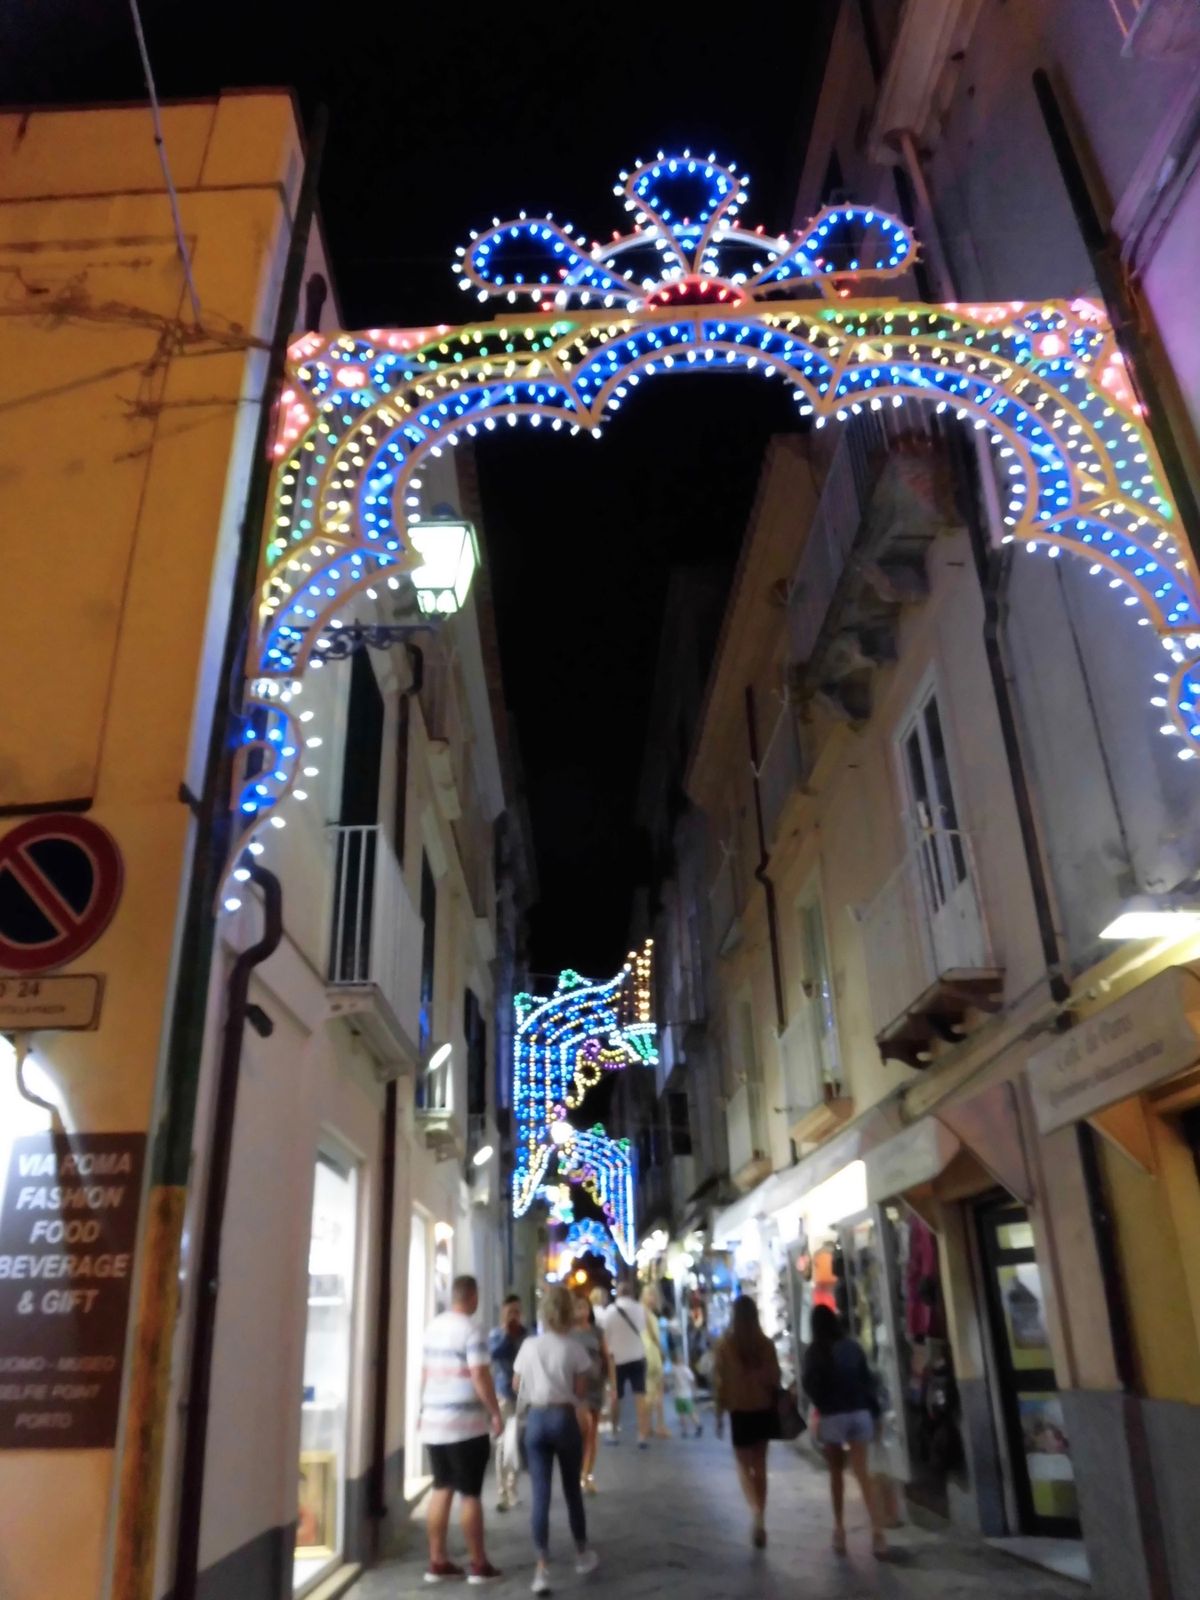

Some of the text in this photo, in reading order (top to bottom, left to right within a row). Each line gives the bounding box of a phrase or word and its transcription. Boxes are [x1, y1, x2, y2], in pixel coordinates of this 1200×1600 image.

[18, 1152, 132, 1177] VIA ROMA
[15, 1186, 124, 1210] FASHION
[29, 1220, 101, 1244] FOOD
[0, 1254, 129, 1279] BEVERAGE
[17, 1289, 99, 1314] & GIFT
